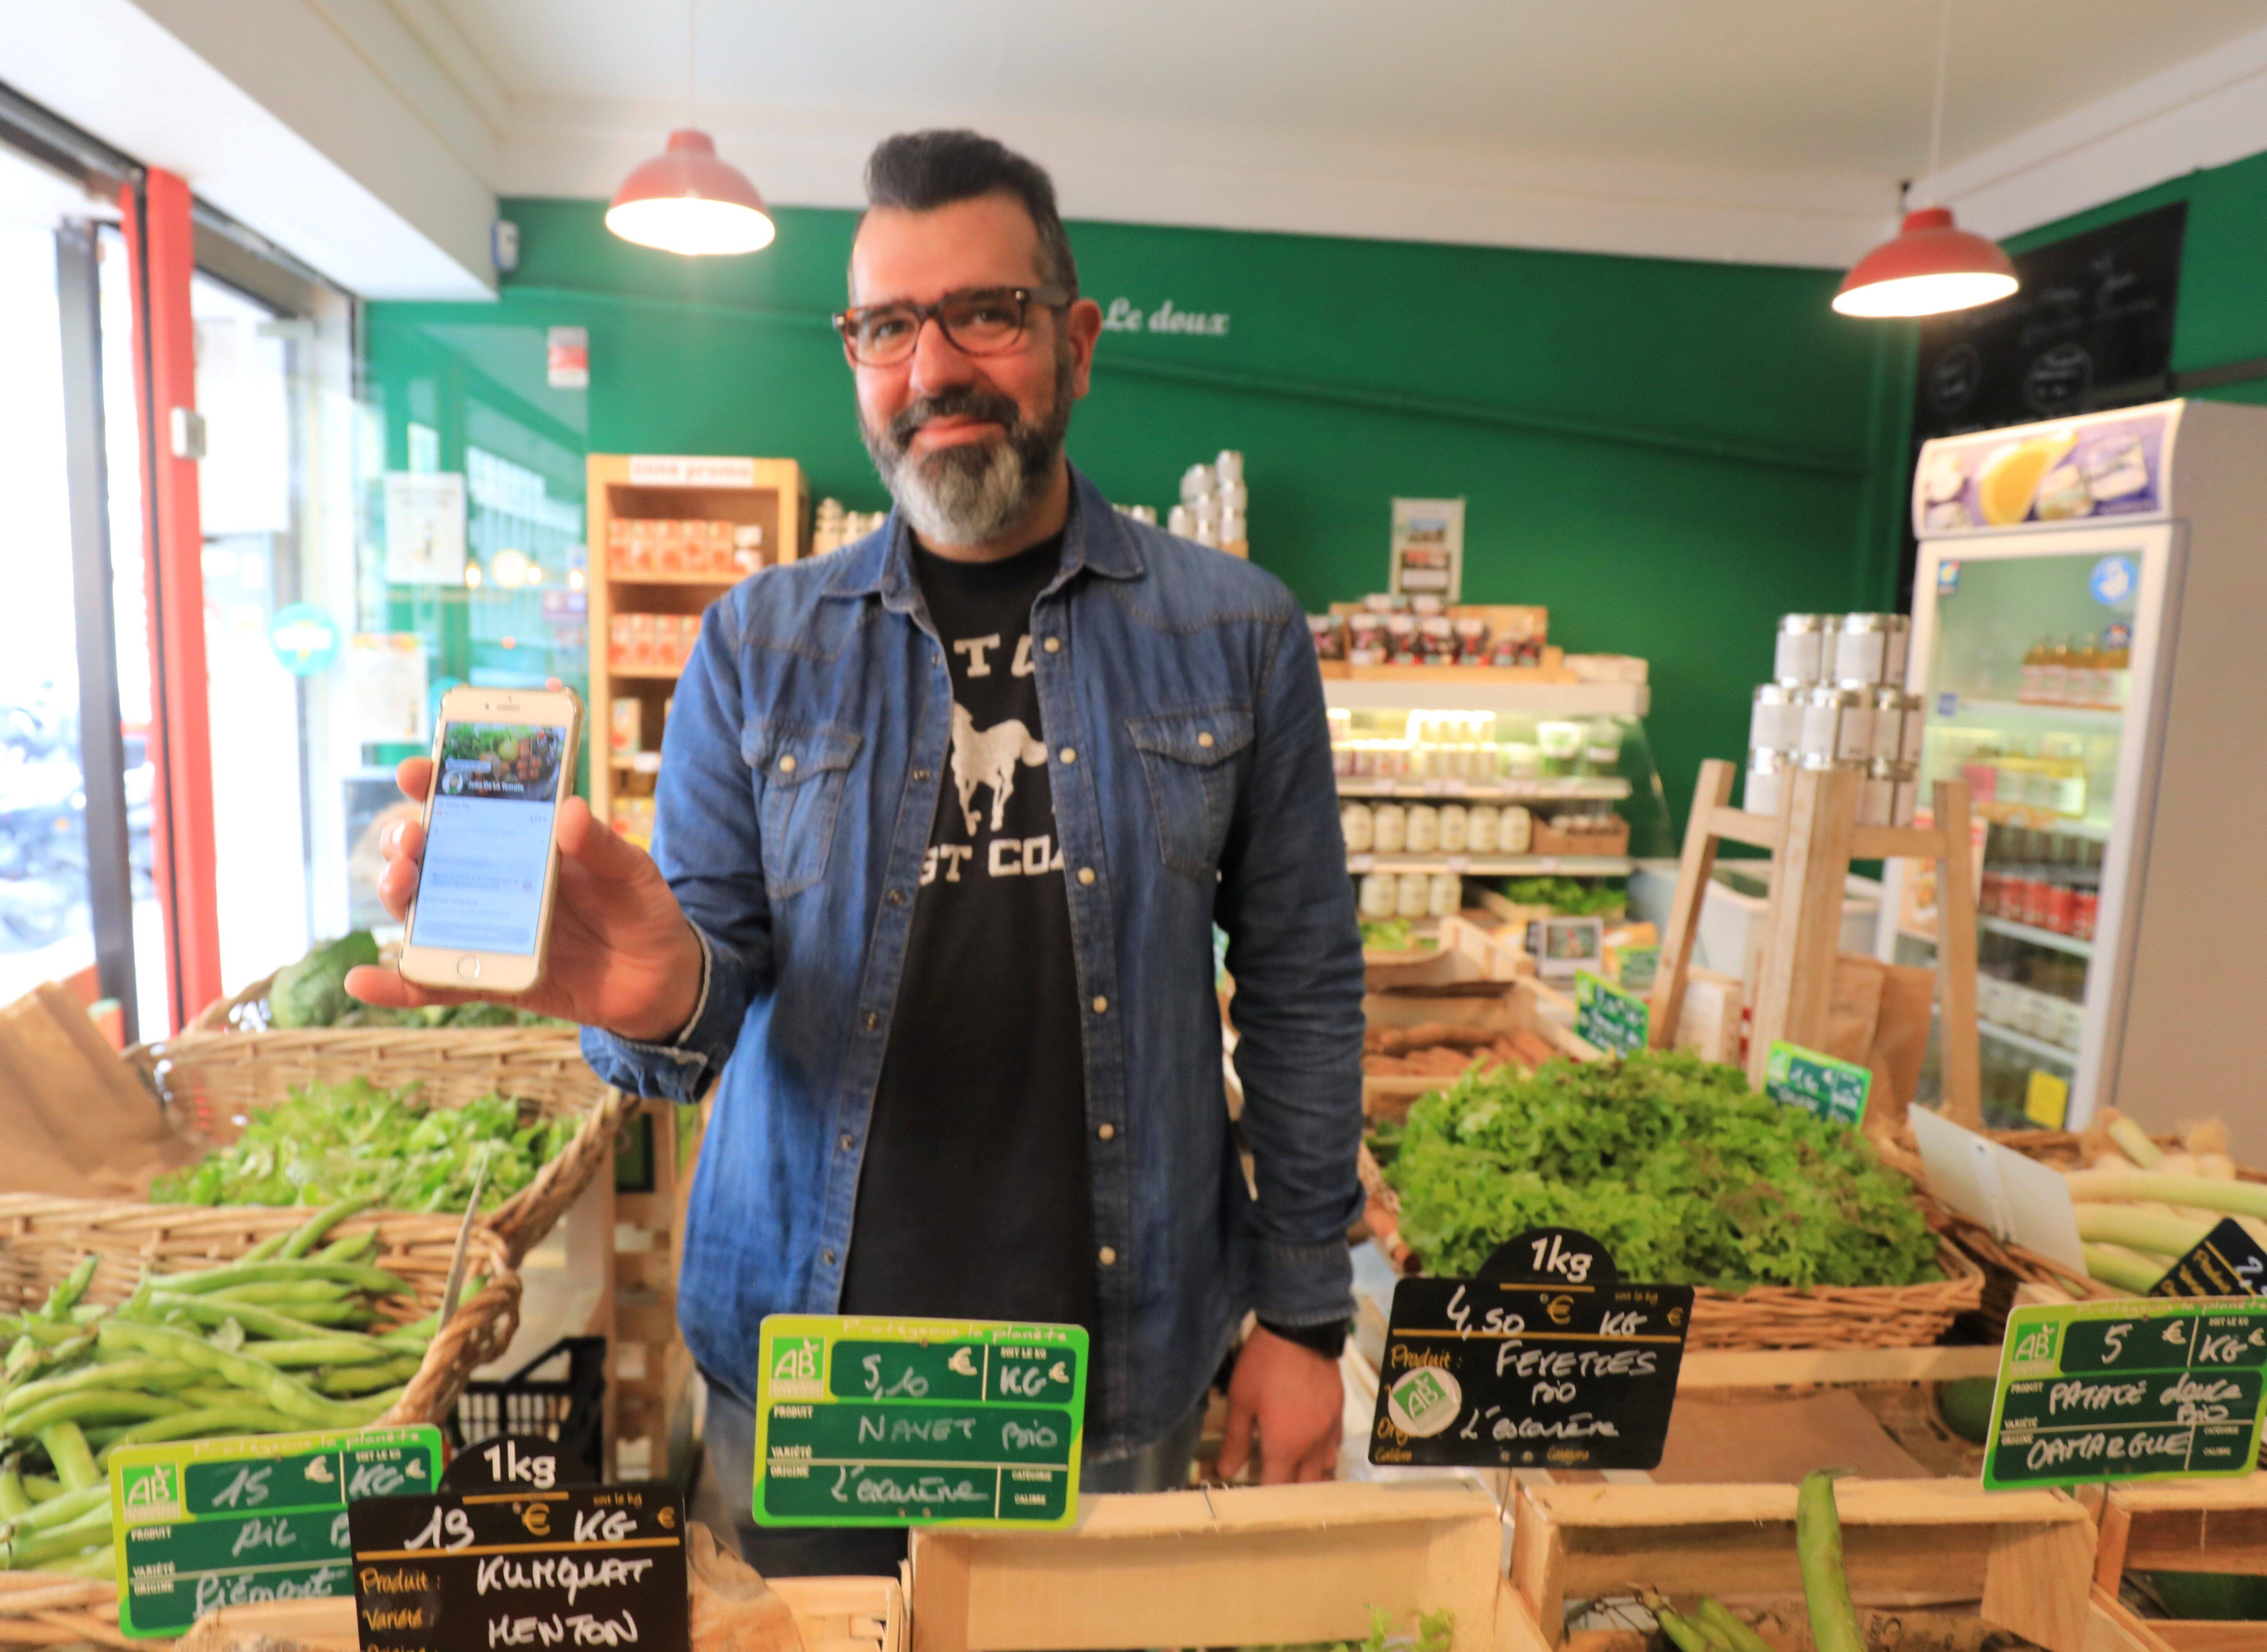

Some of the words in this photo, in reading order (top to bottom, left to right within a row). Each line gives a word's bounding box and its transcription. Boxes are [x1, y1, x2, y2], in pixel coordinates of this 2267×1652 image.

[1532, 1235, 1593, 1282] 1kg
[947, 1346, 977, 1376] €
[2101, 1323, 2133, 1364] 5
[1000, 1365, 1047, 1397] KG
[858, 1414, 977, 1444] NAVET
[483, 1440, 556, 1488] 1kg
[212, 1466, 272, 1508] 15
[404, 1505, 475, 1553] 19
[574, 1509, 637, 1544] KG
